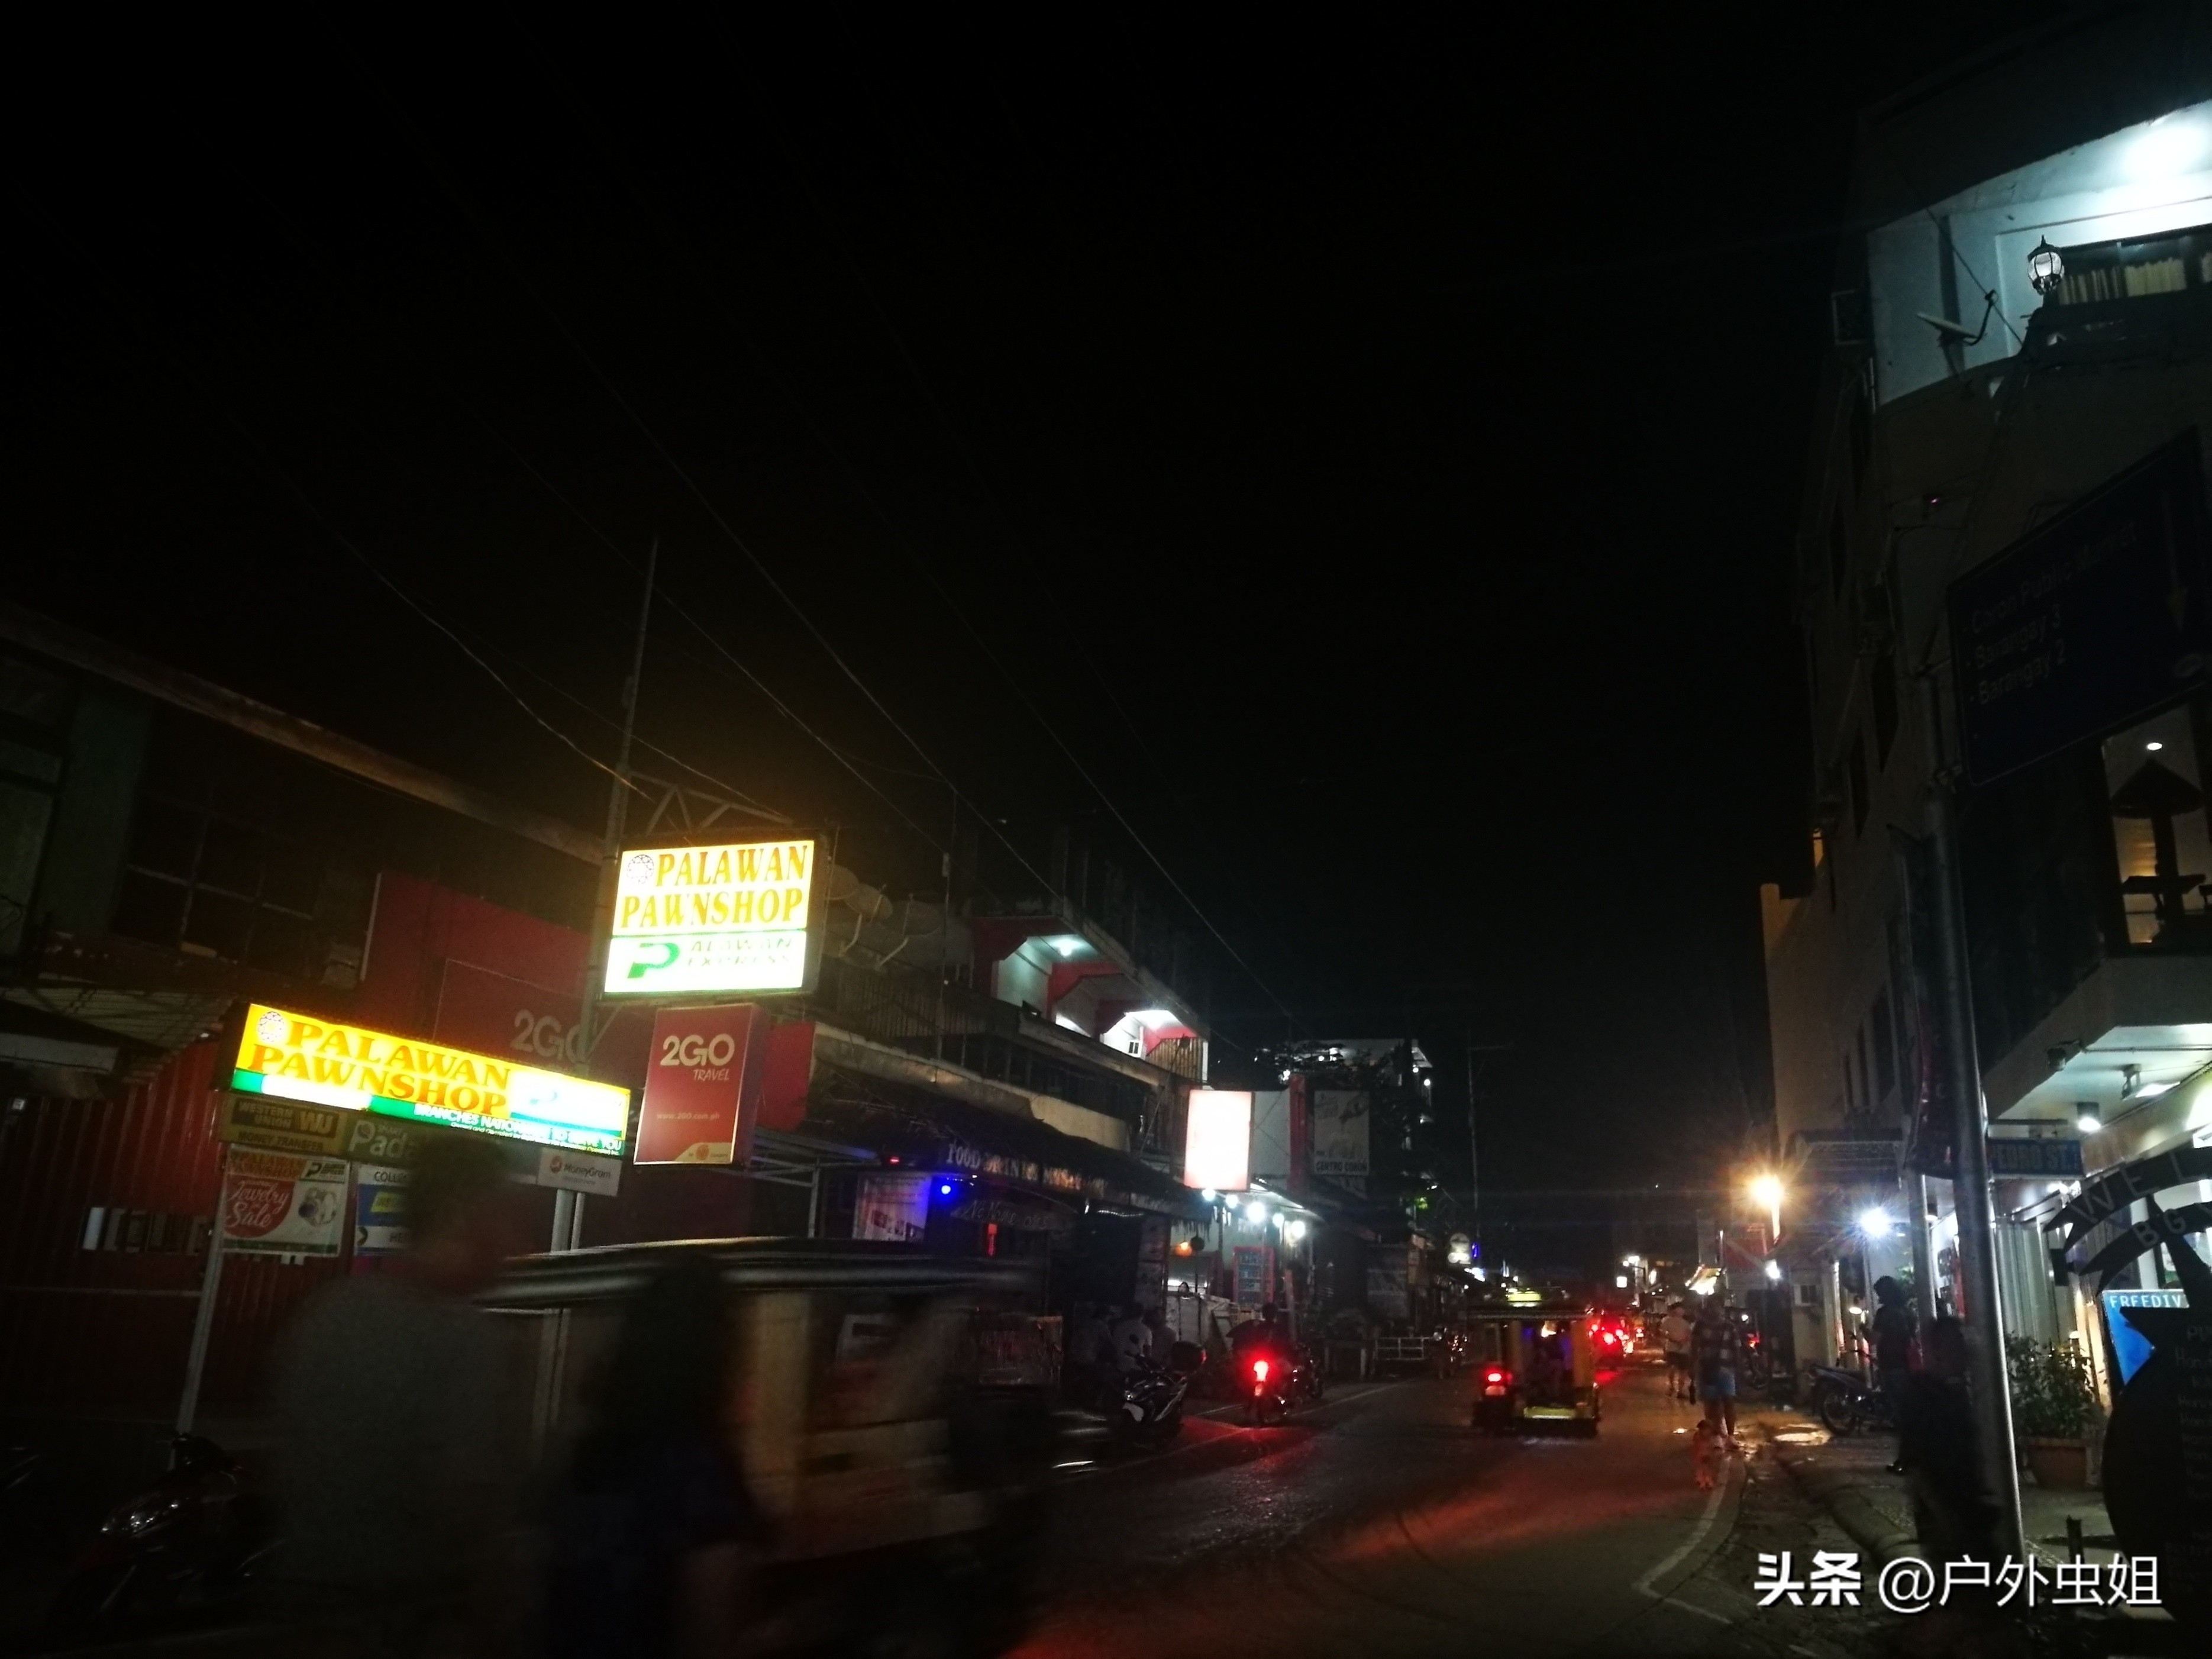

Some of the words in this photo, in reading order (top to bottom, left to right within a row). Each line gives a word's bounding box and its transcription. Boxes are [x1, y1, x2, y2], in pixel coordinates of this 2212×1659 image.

[2020, 561, 2072, 606] Public
[1975, 614, 2047, 669] Barangay
[2052, 603, 2062, 628] 3
[1978, 650, 2050, 704] Barangay
[2055, 638, 2066, 665] 2
[655, 845, 808, 887] PALAWAN
[620, 887, 803, 928] PAWNSHOP
[285, 1019, 511, 1091] PALAWAN
[660, 1033, 735, 1067] 2GO
[248, 1043, 508, 1117] PAWNSHOP
[693, 1068, 731, 1082] TRAVEL
[238, 1101, 293, 1118] WESTERN
[254, 1114, 292, 1129] UNION
[299, 1111, 334, 1135] WU
[276, 1135, 324, 1151] TRANSFER
[946, 1143, 981, 1170] FOOD
[563, 1163, 611, 1179] MoneyGram
[229, 1180, 289, 1215] Jewelry
[225, 1201, 272, 1228] Sale
[2109, 1294, 2184, 1308] FREEDIV
